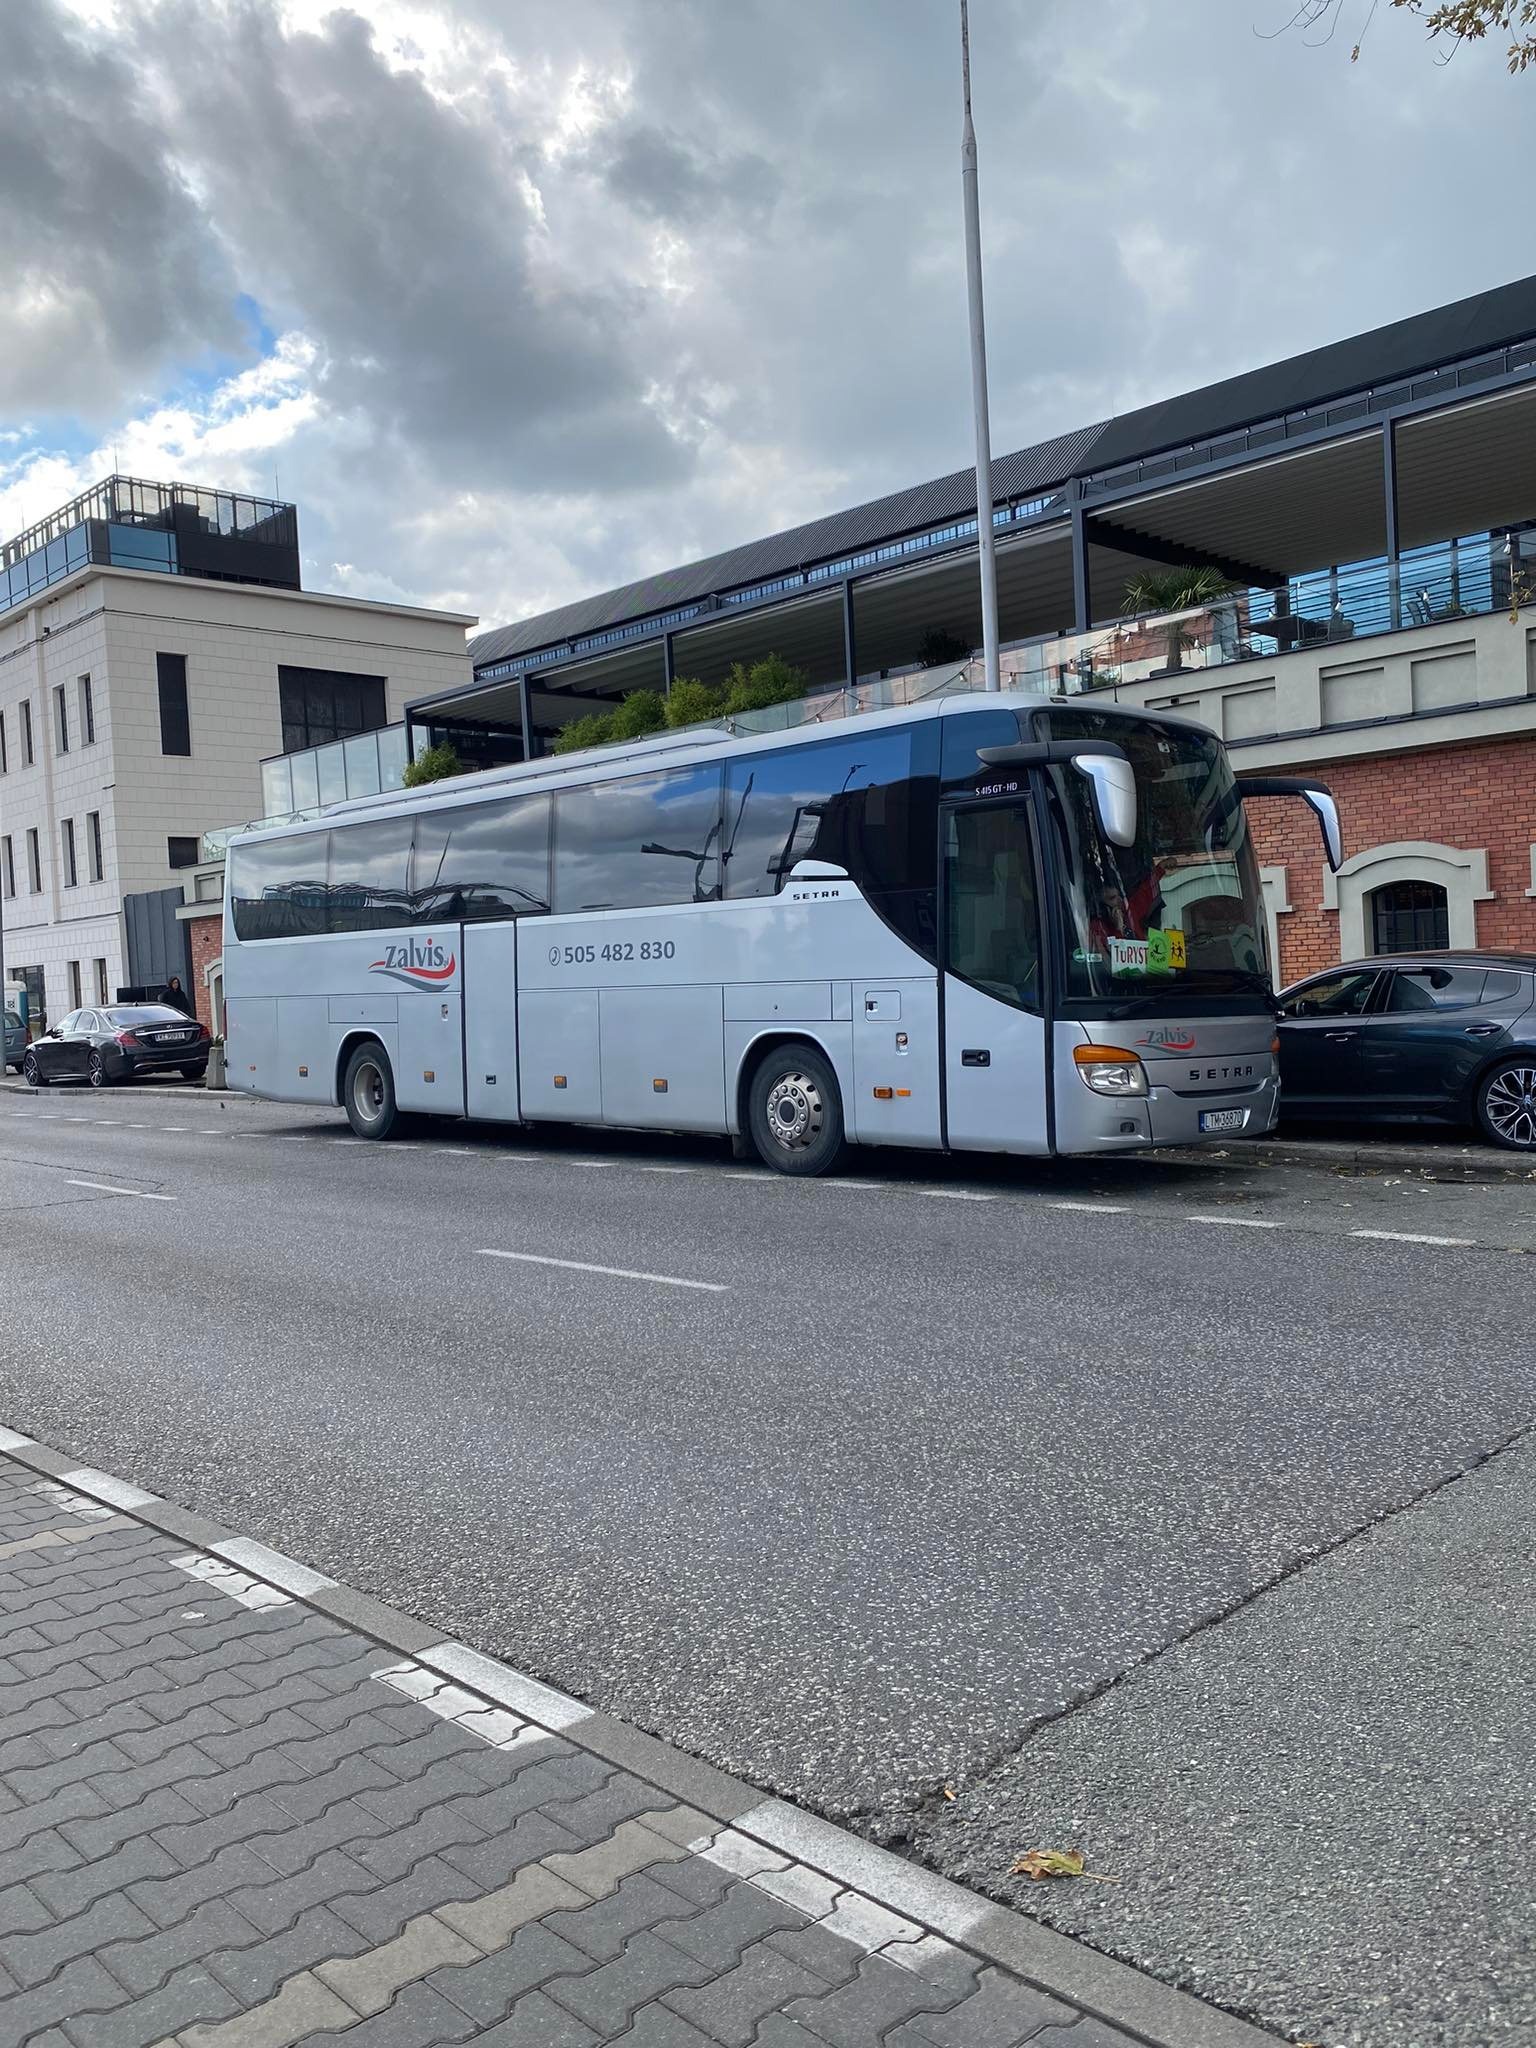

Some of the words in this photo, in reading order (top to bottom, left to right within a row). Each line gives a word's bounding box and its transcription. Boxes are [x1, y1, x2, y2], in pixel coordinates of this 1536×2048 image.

[981, 785, 992, 795] 415
[793, 890, 839, 900] SETRA
[564, 945, 595, 964] 505
[601, 943, 634, 961] 482
[640, 941, 675, 960] 830
[1190, 1066, 1252, 1080] SETRA
